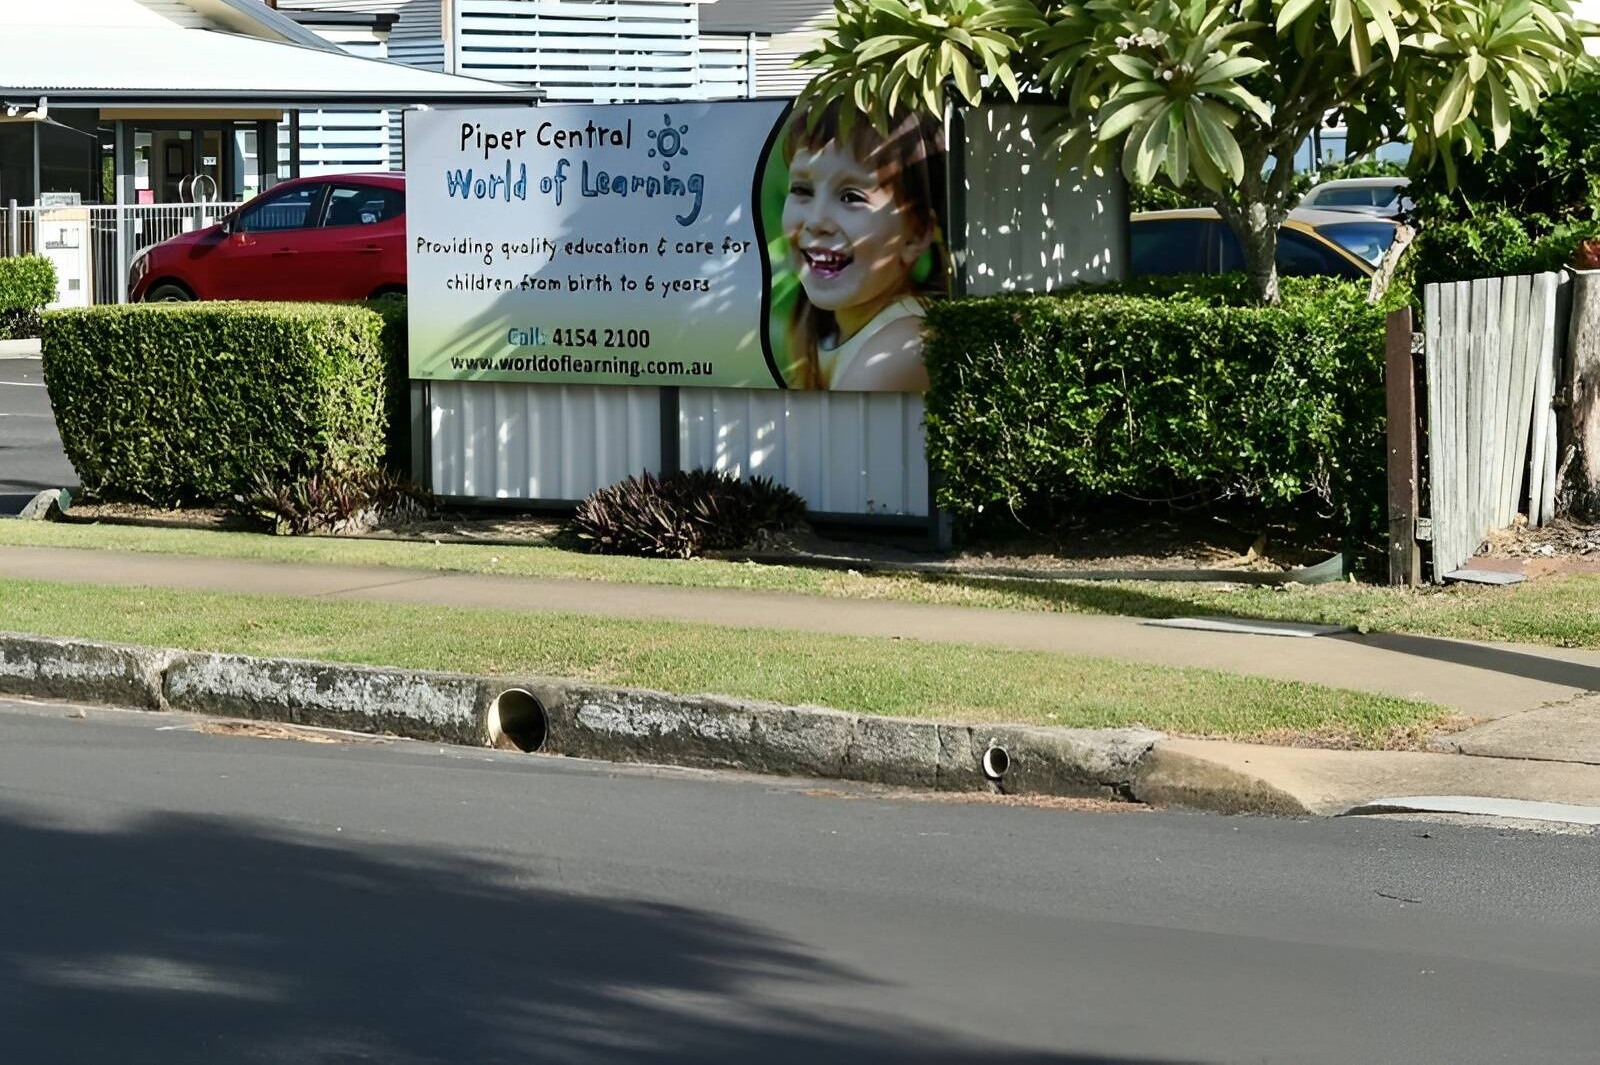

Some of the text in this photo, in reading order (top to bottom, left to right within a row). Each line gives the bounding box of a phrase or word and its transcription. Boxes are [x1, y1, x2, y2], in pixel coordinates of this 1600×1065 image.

[460, 119, 632, 159] Piper Central
[446, 157, 705, 227] World of Learning
[416, 236, 494, 265] Providing
[501, 237, 557, 261] quality
[565, 237, 649, 255] education
[675, 240, 714, 255] care
[721, 236, 751, 255] for
[446, 273, 711, 299] children from birth to 6 years
[507, 327, 650, 348] Call: 4154 2100
[450, 354, 713, 378] www.worldoflearning.com.au
